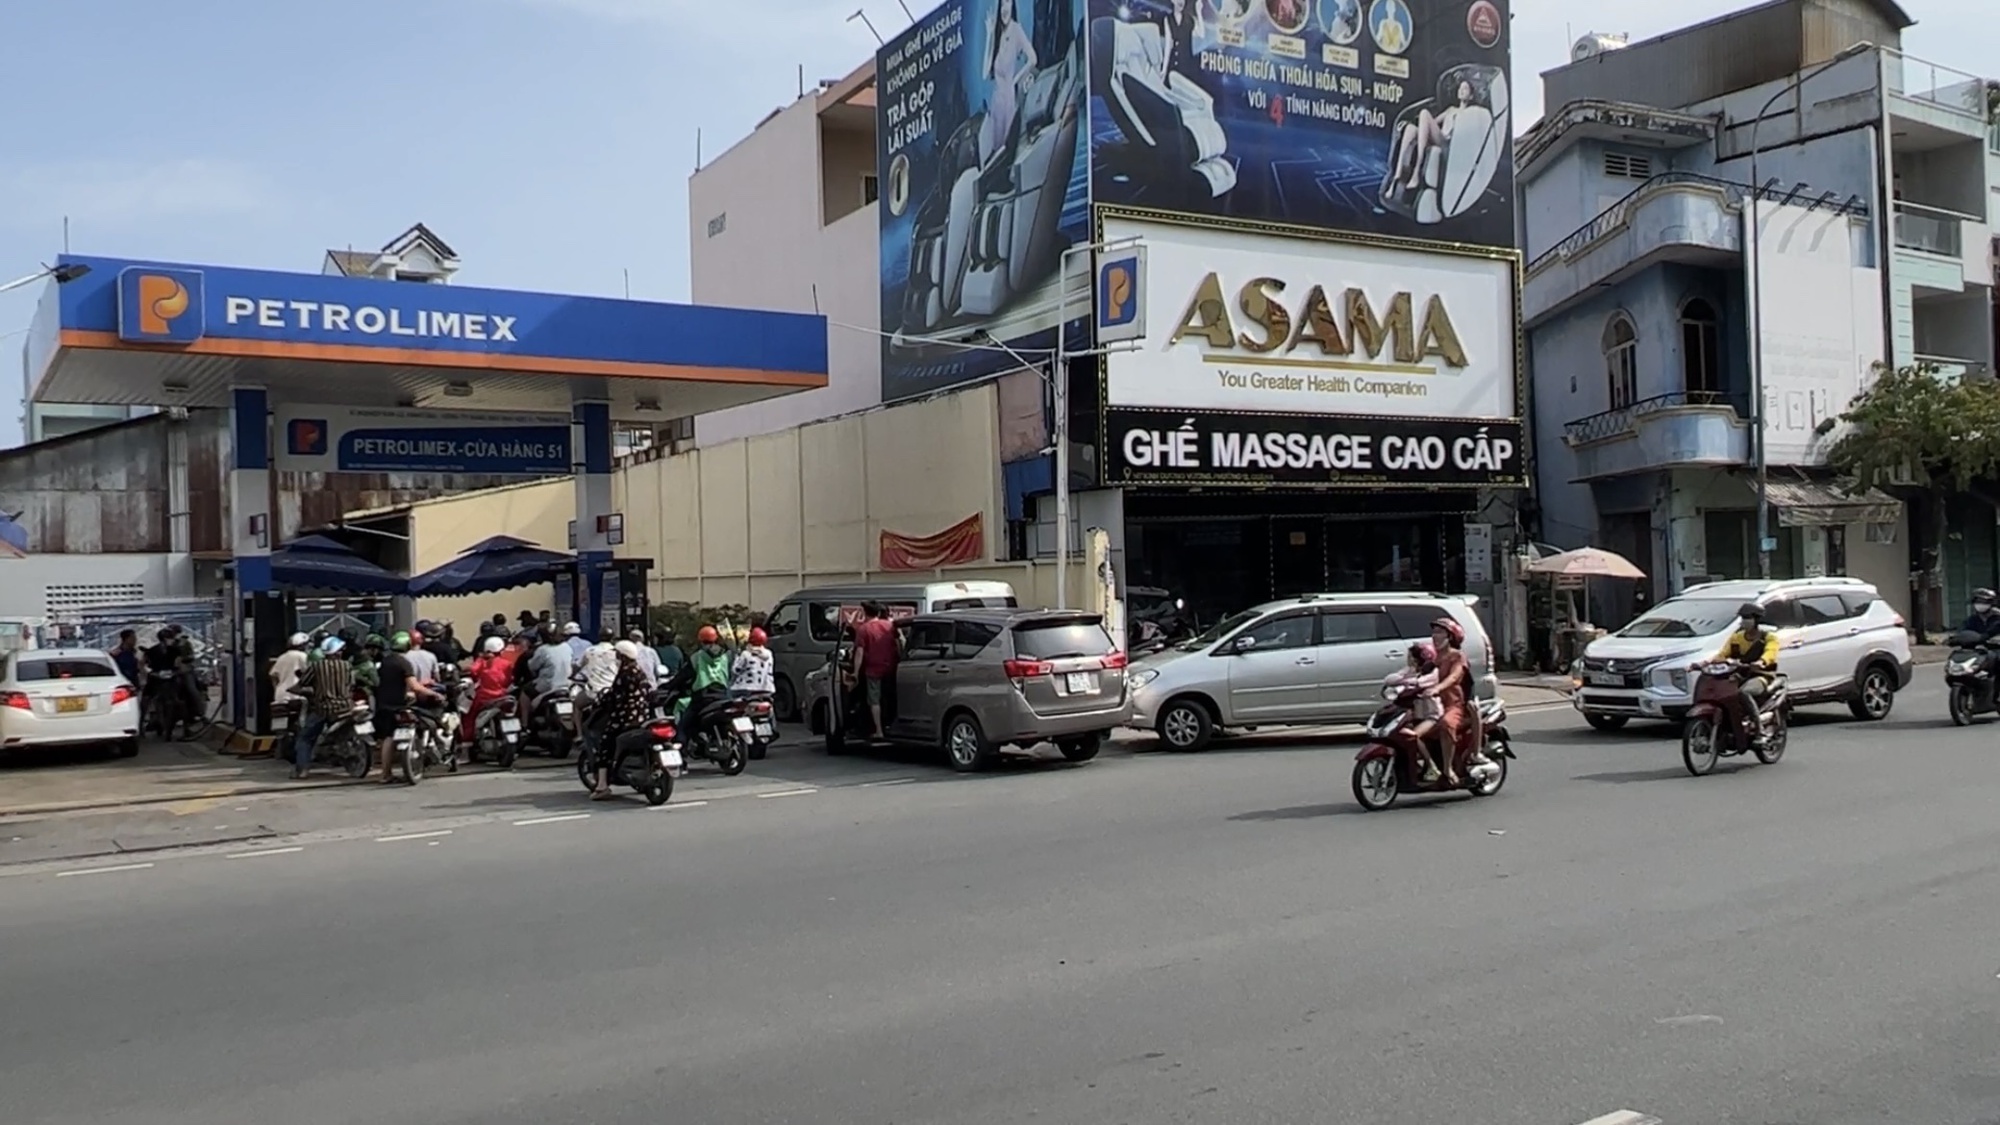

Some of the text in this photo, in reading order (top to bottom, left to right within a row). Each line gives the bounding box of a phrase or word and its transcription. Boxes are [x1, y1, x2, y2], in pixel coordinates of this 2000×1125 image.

[886, 6, 963, 72] MUA GHẾ MASSAGE
[887, 27, 963, 95] KHÔNG LO VỀ GIÁ
[1201, 51, 1241, 77] PHÒNG
[1245, 57, 1277, 82] NGỪA
[1280, 64, 1313, 88] THOÁI
[1315, 69, 1337, 91] HÓA
[1340, 75, 1363, 97] SỤN
[1373, 80, 1403, 104] KHỚP
[887, 80, 935, 127] TRẢ GÓP
[1248, 89, 1385, 128] VỚI 4 TÍNH NĂNG ĐỘC ĐÁO
[887, 106, 933, 154] LÃI SUẤT
[226, 296, 517, 342] PETROLIMEX
[1169, 272, 1469, 367] ASAMA
[1218, 370, 1427, 398] You Greater Health Companion
[502, 442, 544, 458] HÀNG
[548, 444, 563, 458] 51
[1124, 418, 1512, 470] GHẾ MASSAGE CAO CẤP
